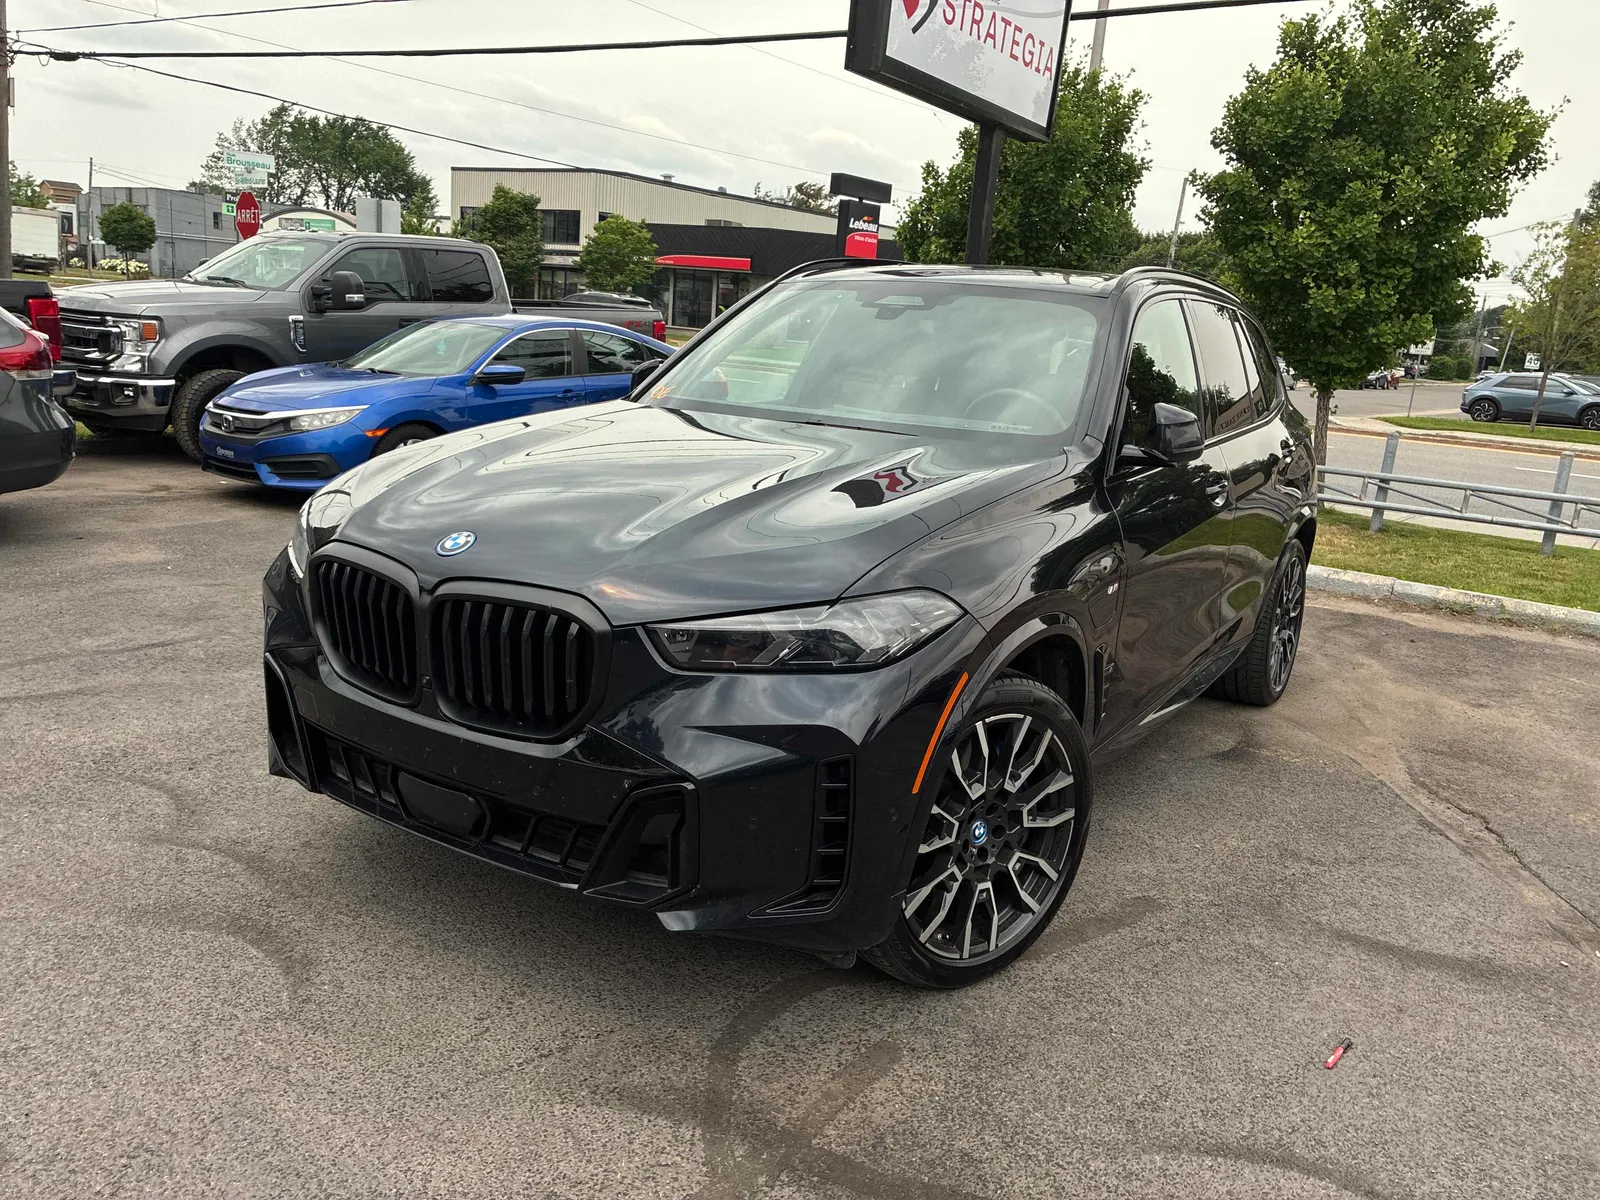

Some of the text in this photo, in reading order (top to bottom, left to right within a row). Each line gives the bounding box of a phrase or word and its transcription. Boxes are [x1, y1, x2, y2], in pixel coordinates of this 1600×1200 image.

[943, 0, 1054, 81] STRATEGIA
[226, 157, 271, 169] Brousseau
[237, 206, 258, 224] ARRÊT
[849, 218, 878, 231] Lebeau
